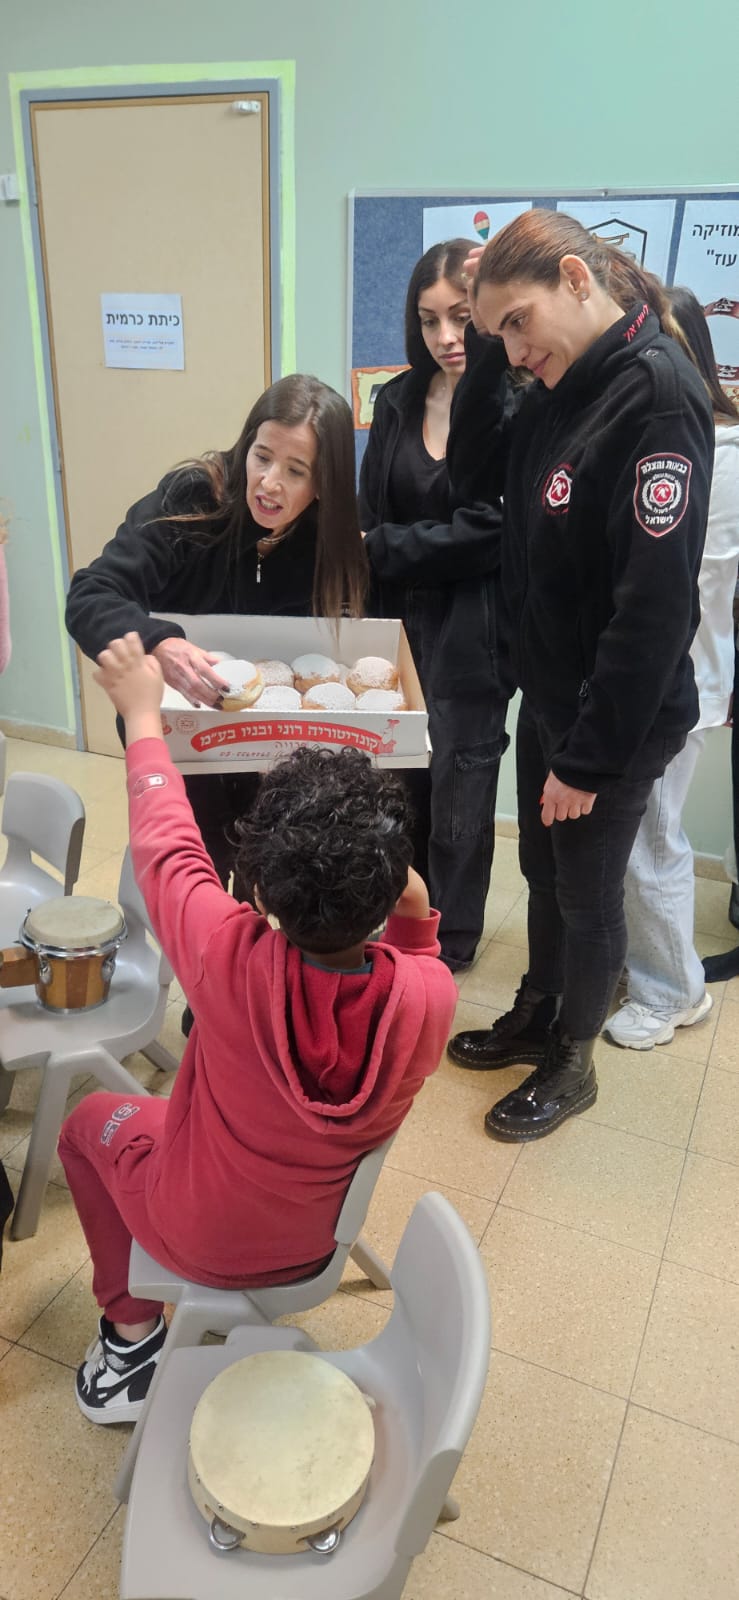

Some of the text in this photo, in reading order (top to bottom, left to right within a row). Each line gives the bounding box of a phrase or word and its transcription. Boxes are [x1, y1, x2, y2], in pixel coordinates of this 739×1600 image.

[706, 249, 737, 267] עוז"
[106, 312, 180, 326] כיתת כרמית
[640, 459, 688, 475] כבאות והצלה
[645, 514, 674, 525] לישראל
[200, 724, 379, 751] קונדיטוריה רוני ובניו בע"מ
